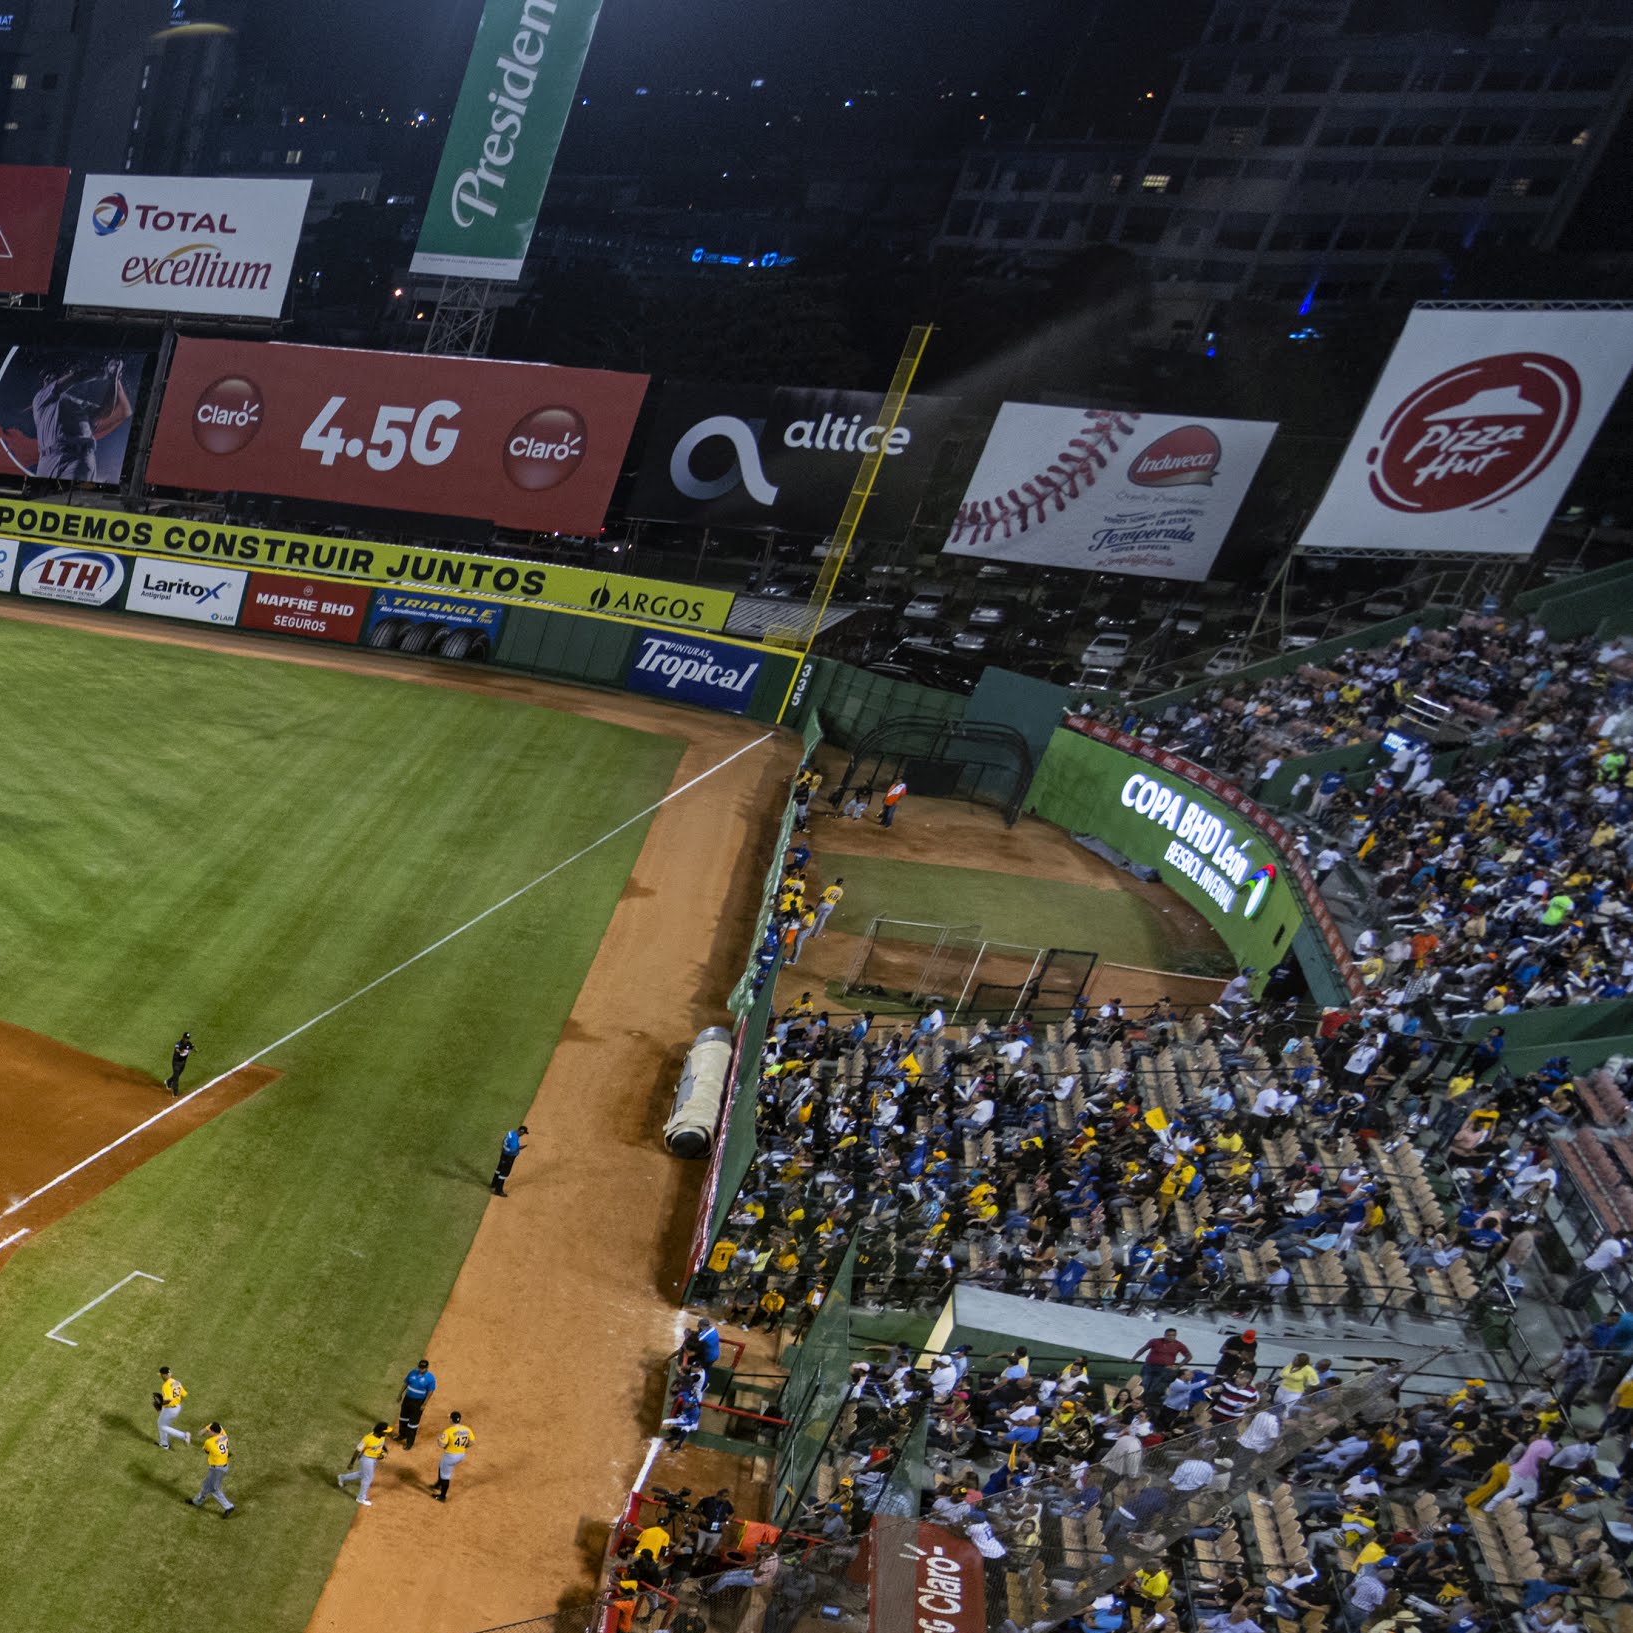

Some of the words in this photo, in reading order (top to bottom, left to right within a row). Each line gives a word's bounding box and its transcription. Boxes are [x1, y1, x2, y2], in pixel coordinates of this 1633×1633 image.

[135, 203, 238, 235] TOTAL
[120, 250, 273, 291] excellium
[196, 403, 250, 428] Claro
[300, 395, 464, 473] 4.5G
[508, 435, 574, 461] Claro
[783, 412, 912, 456] altice
[1403, 419, 1527, 464] Pizza
[1136, 452, 1214, 474] Induveca
[1412, 450, 1512, 487] Hut
[1088, 521, 1195, 551] Temporada
[38, 558, 104, 591] LTH
[163, 526, 375, 575] CONSTRUIR
[386, 553, 548, 596] JUNTOS
[140, 590, 172, 601] Antigripal
[143, 574, 228, 604] Laritox
[255, 593, 318, 612] MAPFRE
[320, 601, 355, 617] BHD
[393, 597, 498, 617] TRIANGLE
[613, 590, 705, 622] ARGOS
[272, 615, 327, 633] SEGUROS
[636, 637, 759, 692] Tropical
[668, 642, 711, 658] PINTURAS
[790, 664, 813, 707] 335
[1121, 773, 1185, 831] COPA
[1175, 802, 1226, 854] BHD
[1213, 825, 1254, 887] León
[1163, 839, 1204, 889] BEISBOL
[1195, 861, 1236, 914] INVERNAL
[917, 1556, 962, 1616] Claro
